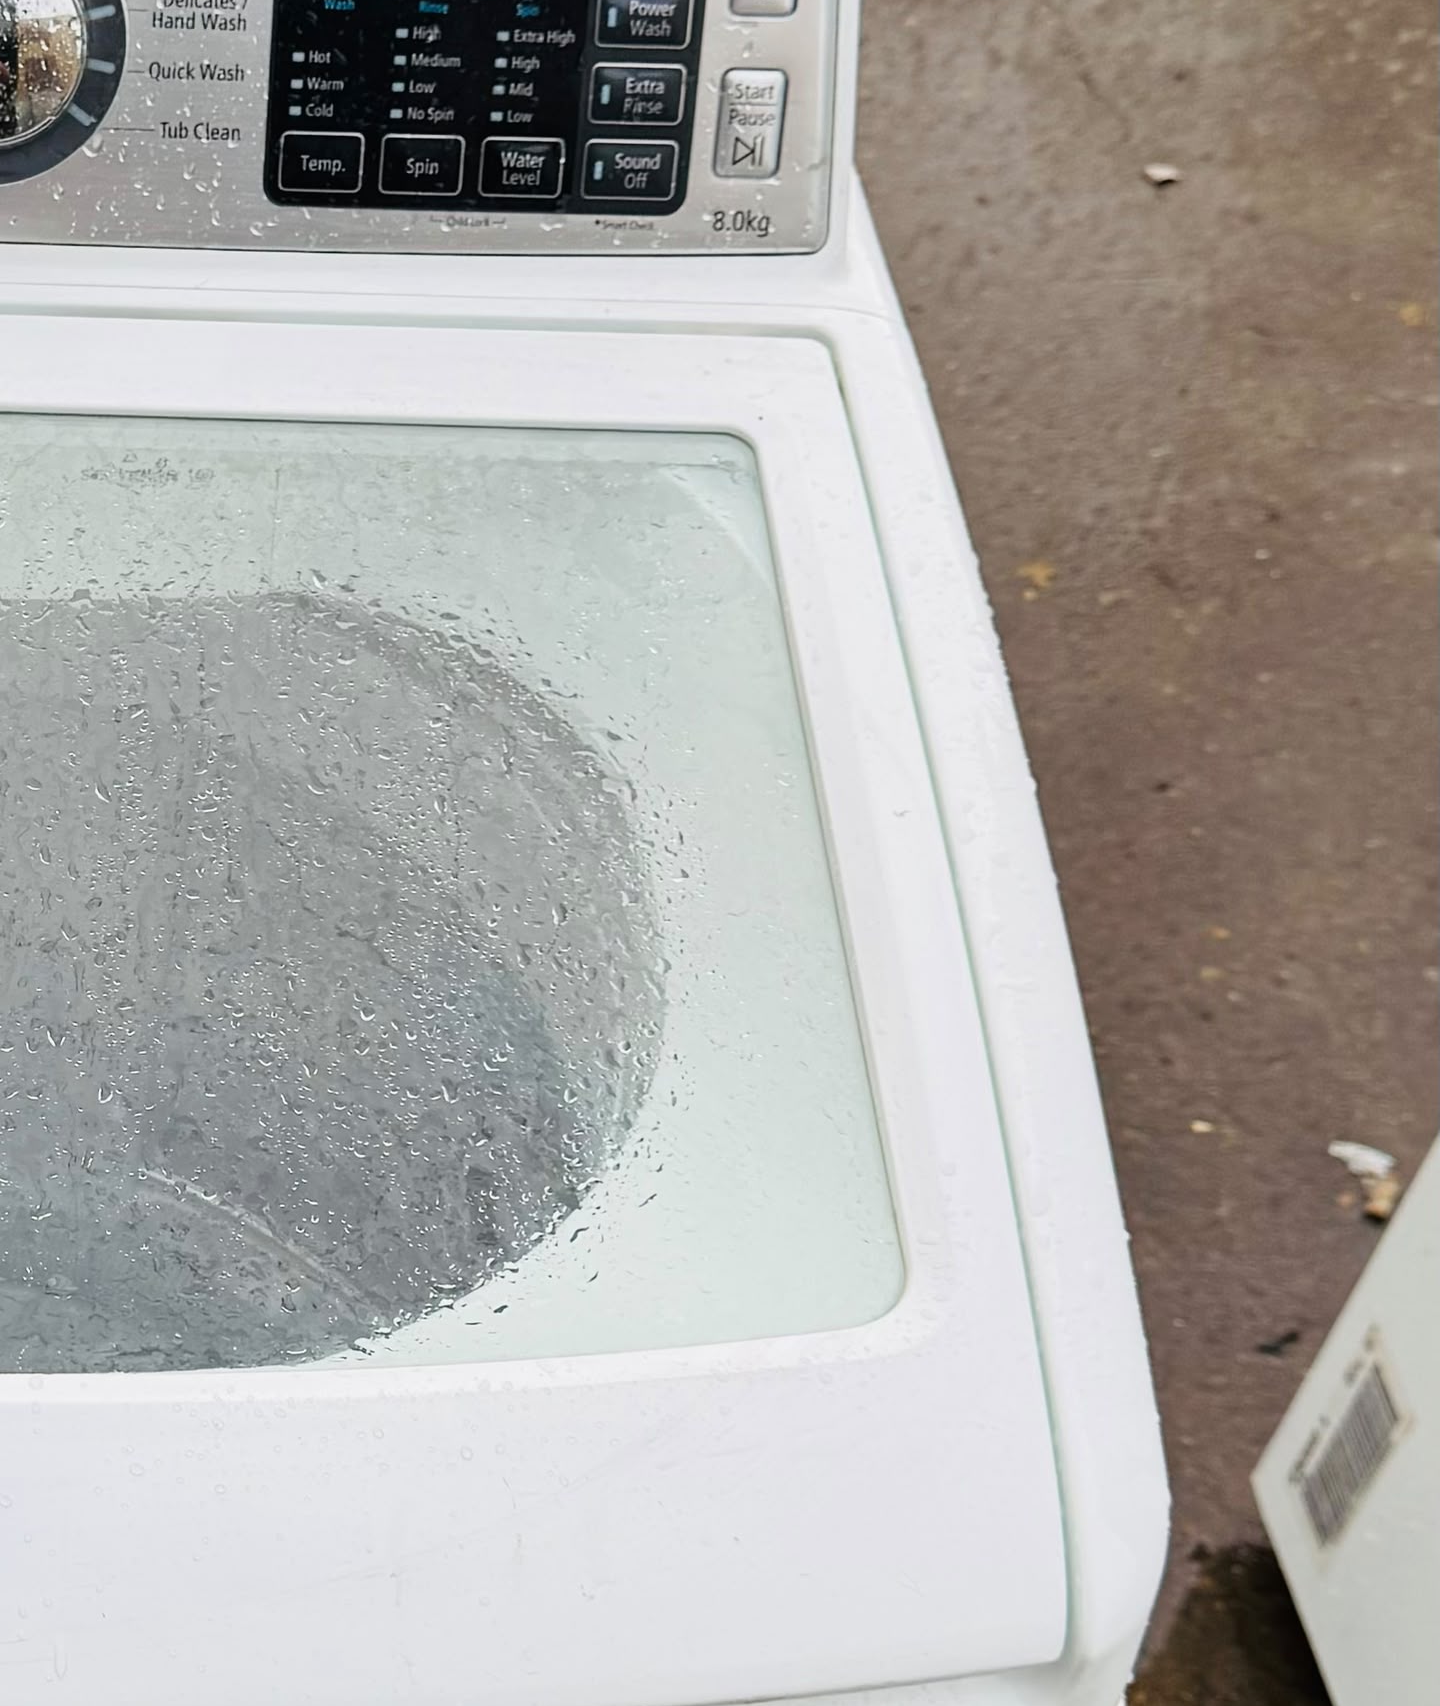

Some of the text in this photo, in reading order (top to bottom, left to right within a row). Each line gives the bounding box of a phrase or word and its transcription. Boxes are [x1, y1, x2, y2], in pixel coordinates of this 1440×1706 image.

[629, 0, 677, 18] Power
[152, 11, 248, 32] Hand Wash
[630, 19, 672, 38] Wash
[513, 28, 576, 47] Extra High
[308, 50, 331, 64] Hot
[410, 53, 462, 68] Medium
[510, 55, 541, 73] High
[149, 61, 245, 82] Quick Wash
[306, 77, 345, 91] Warm
[409, 79, 437, 94] Low
[508, 82, 534, 97] Mid
[625, 76, 665, 95] Extra
[733, 81, 776, 101] Start
[305, 103, 334, 118] Cold
[407, 106, 455, 124] No Spin
[623, 97, 664, 115] Rinse
[506, 110, 534, 124] Low
[728, 108, 776, 127] Pause
[161, 121, 242, 141] Tub Clean
[300, 154, 346, 176] Temp.
[405, 157, 439, 178] Spin
[500, 151, 545, 169] Water
[614, 152, 662, 171] Sound
[502, 169, 542, 186] Level
[623, 172, 648, 190] Off
[711, 210, 771, 237] 8.0kg
